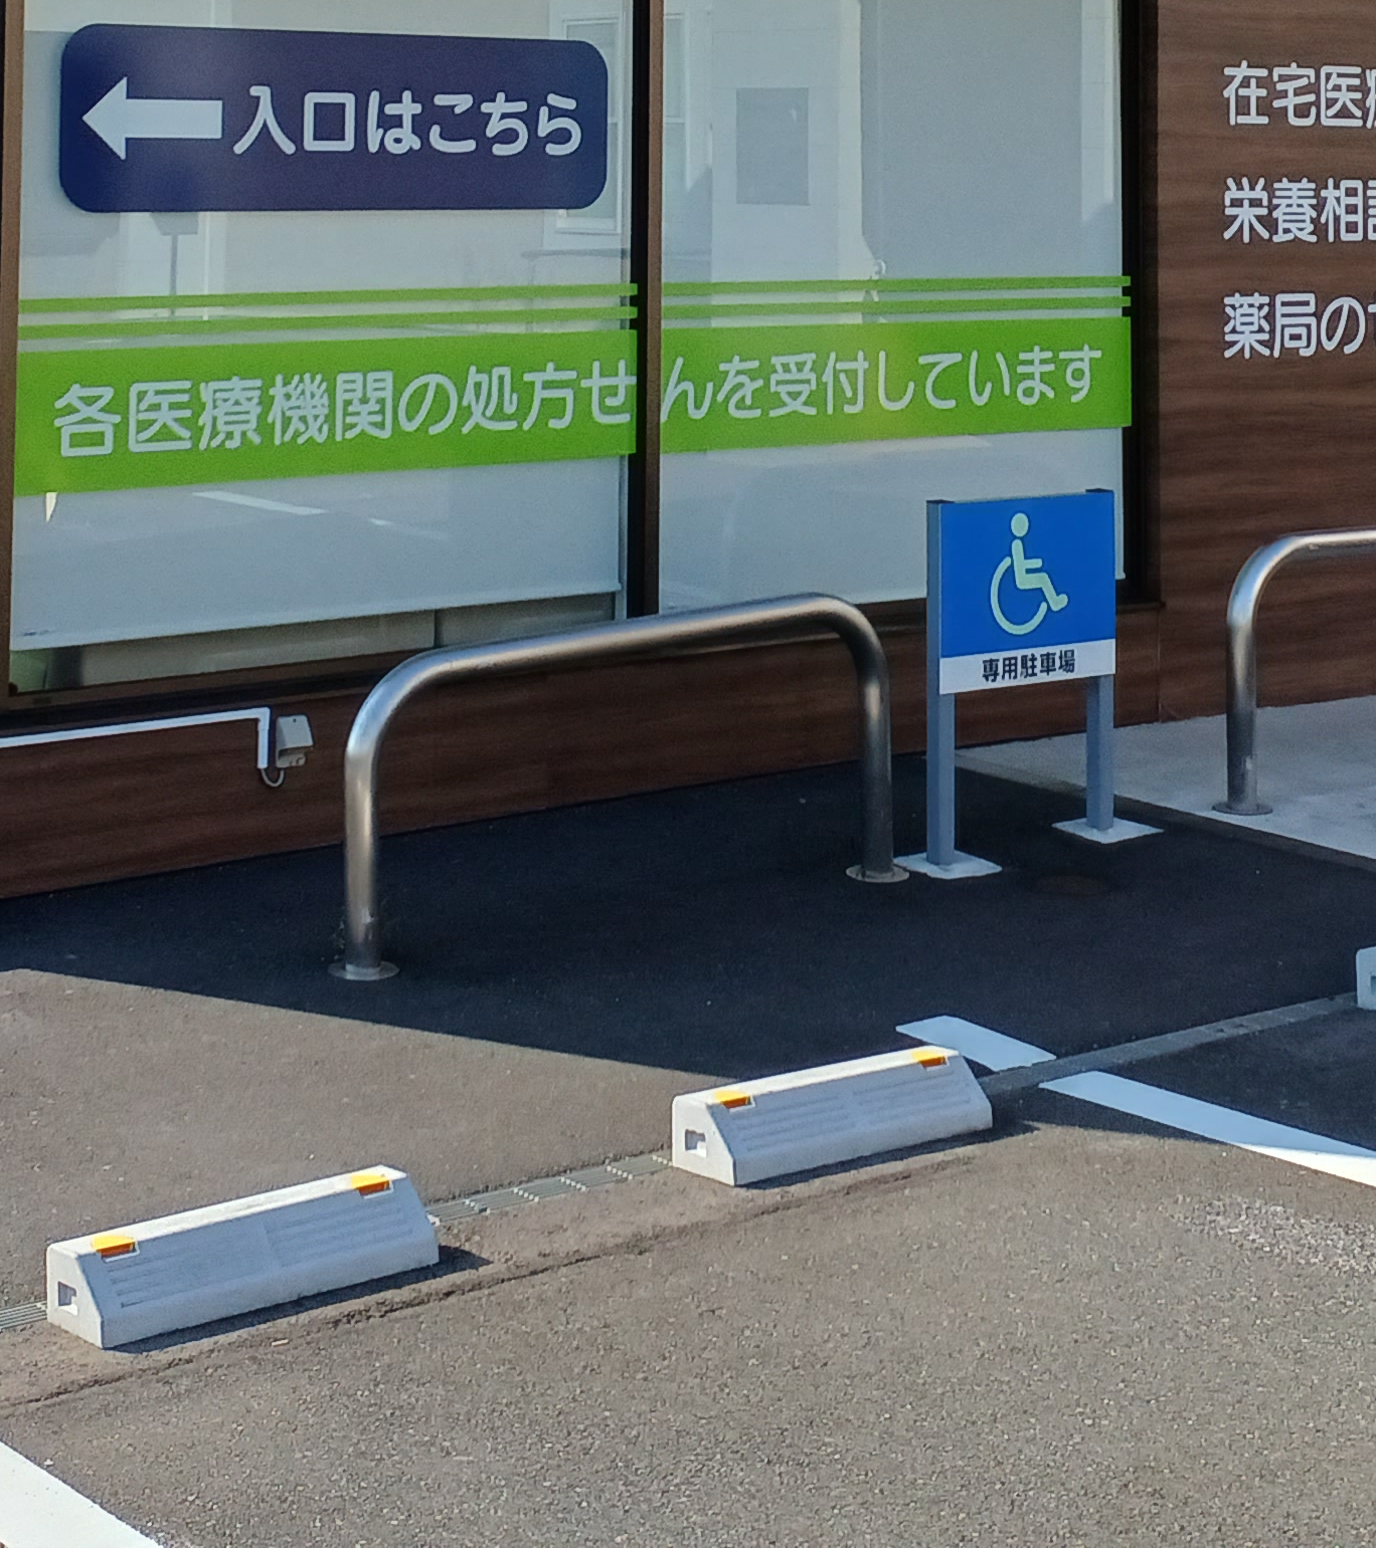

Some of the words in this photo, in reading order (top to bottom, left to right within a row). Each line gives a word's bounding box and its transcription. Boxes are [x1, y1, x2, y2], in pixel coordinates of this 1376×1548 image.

[233, 85, 582, 156] 入口はこちら
[982, 649, 1076, 682] 専用駐車場
